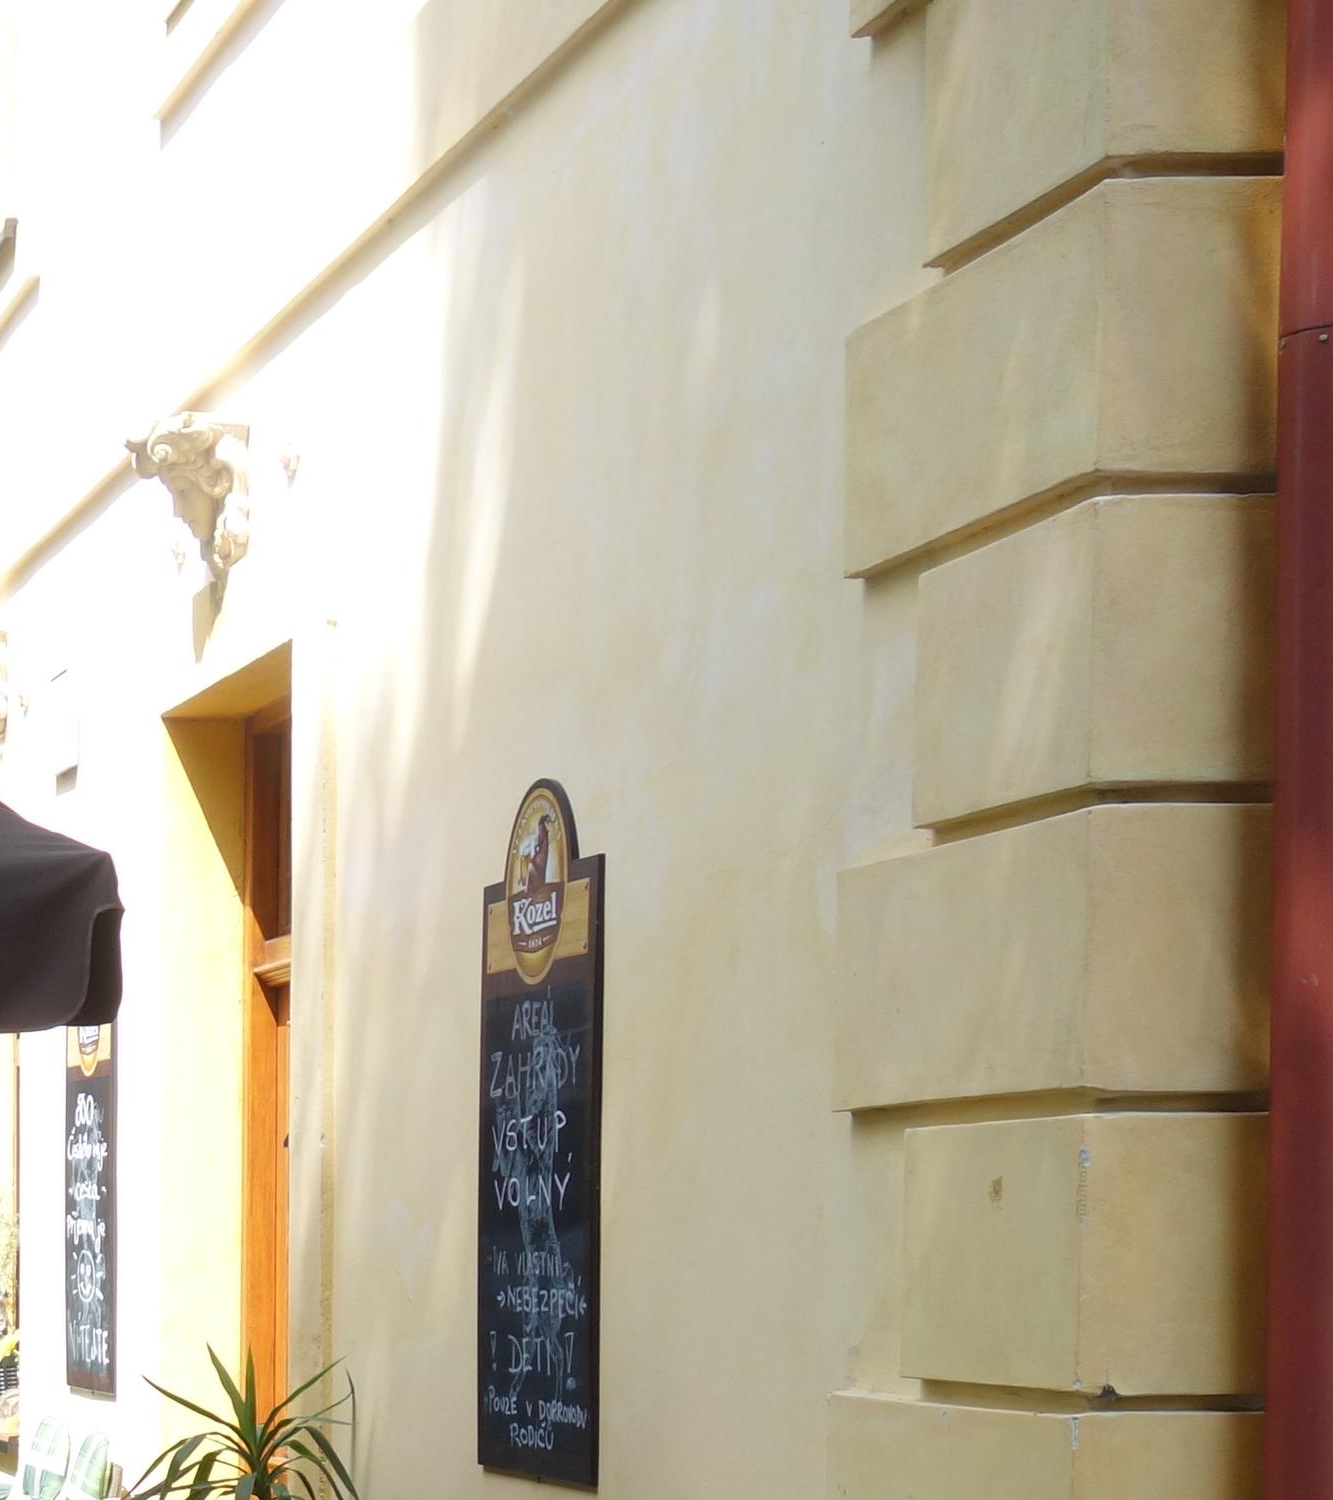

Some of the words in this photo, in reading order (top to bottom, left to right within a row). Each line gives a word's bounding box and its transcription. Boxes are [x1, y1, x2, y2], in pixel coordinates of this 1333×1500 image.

[512, 891, 558, 937] Kozel
[491, 1110, 567, 1154] VSTUP
[493, 1153, 573, 1211] VOLNÝ
